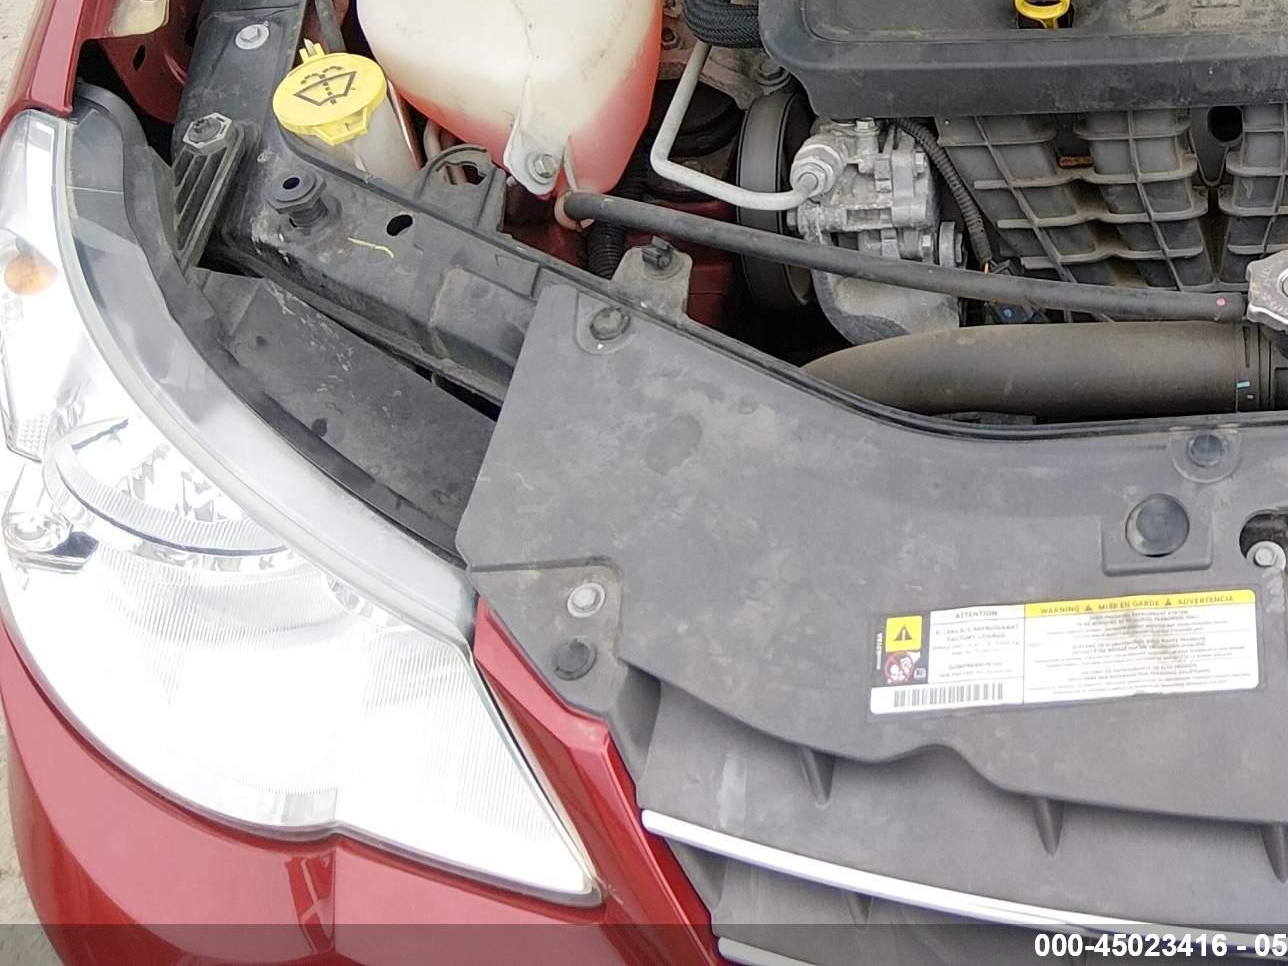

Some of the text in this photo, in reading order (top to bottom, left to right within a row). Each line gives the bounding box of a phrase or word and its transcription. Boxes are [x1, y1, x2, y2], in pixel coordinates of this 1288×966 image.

[1040, 605, 1080, 614] WARNING
[1132, 599, 1160, 608] GARDE
[1177, 595, 1234, 605] ADVERTENCIA
[955, 610, 998, 619] ATTENTION
